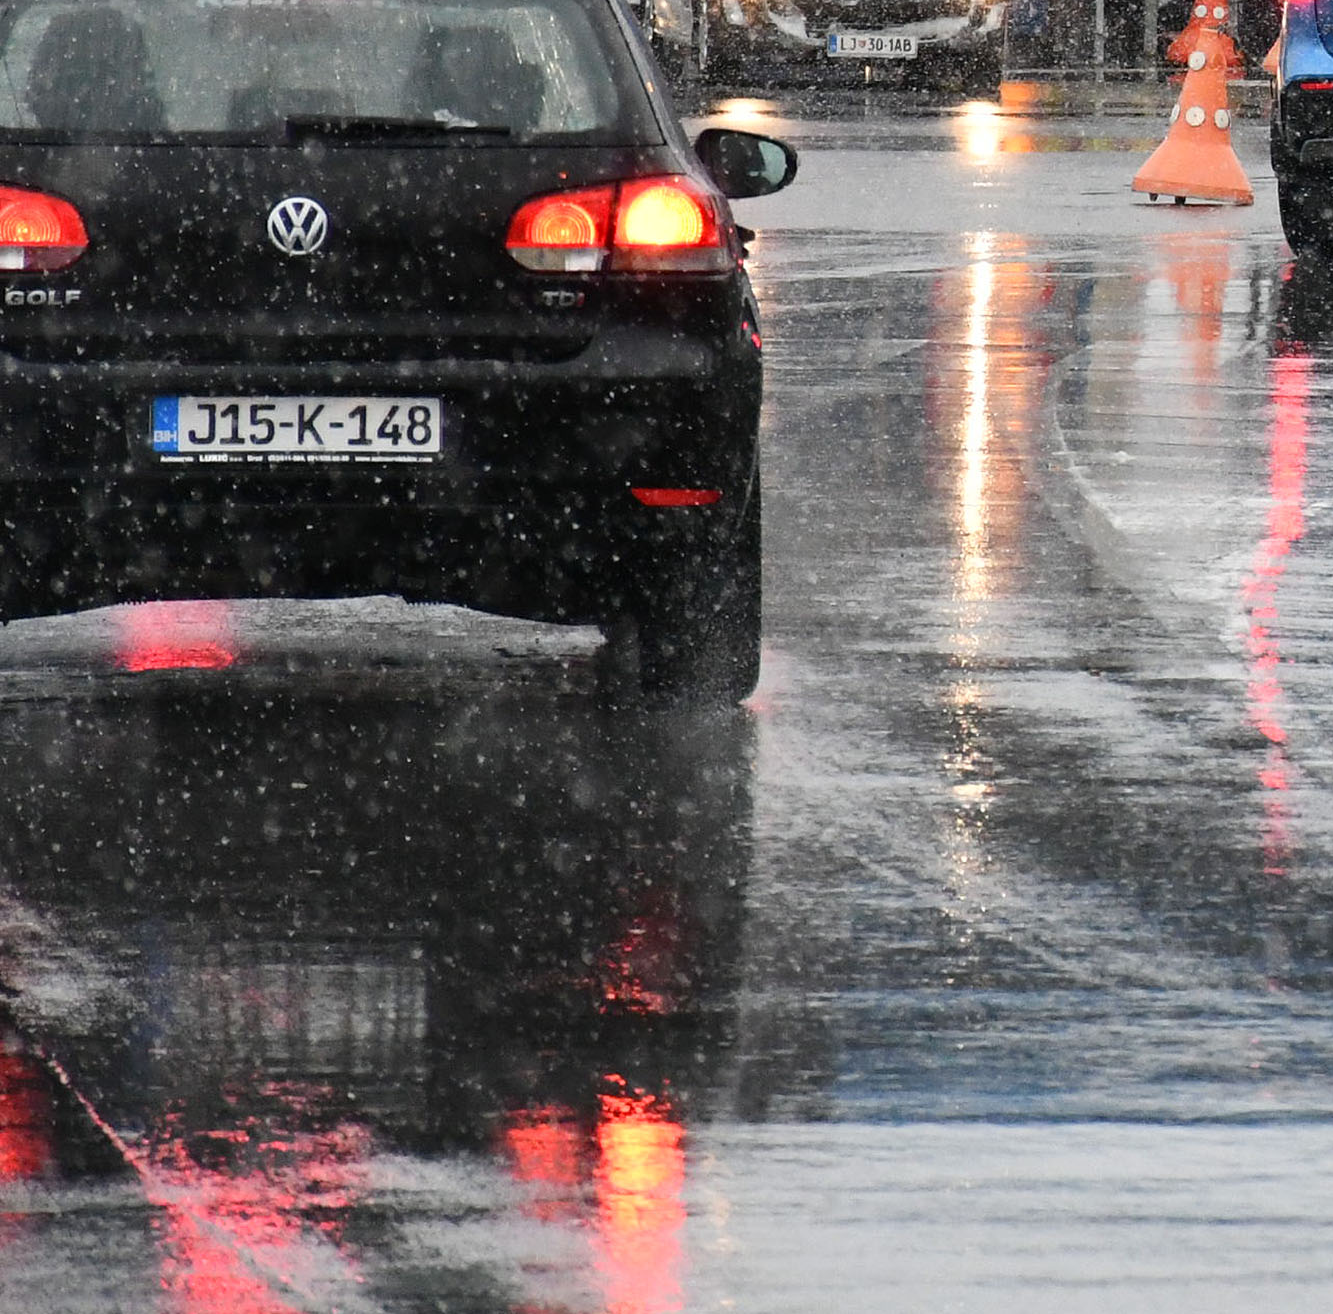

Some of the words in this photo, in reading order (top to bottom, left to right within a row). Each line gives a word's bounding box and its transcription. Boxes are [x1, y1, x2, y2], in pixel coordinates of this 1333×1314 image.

[4, 289, 82, 306] GOLF
[188, 403, 433, 446] J15-K-148
[154, 430, 177, 443] BIH
